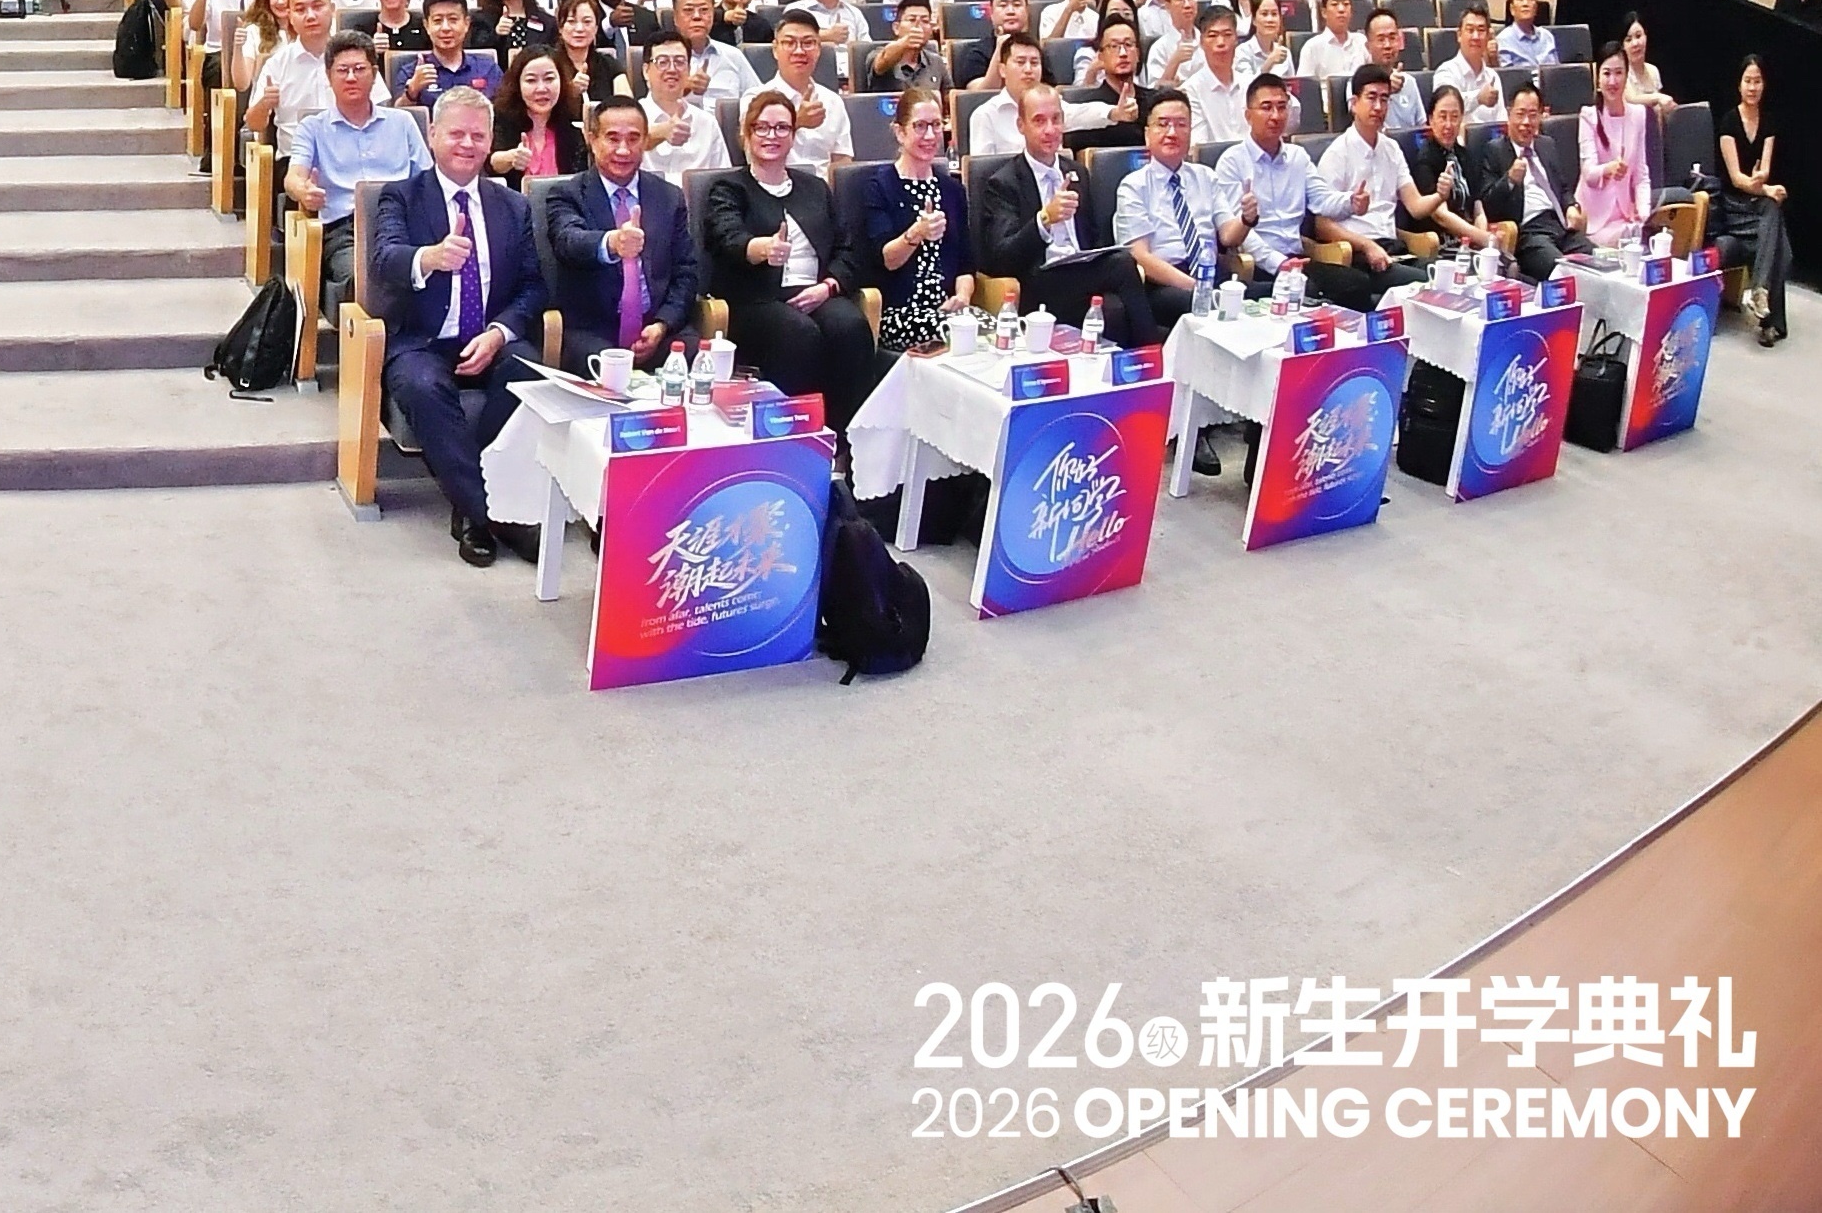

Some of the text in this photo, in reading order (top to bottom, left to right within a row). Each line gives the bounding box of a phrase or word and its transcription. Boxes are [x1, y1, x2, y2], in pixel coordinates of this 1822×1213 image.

[1056, 510, 1132, 561] Hello
[666, 621, 685, 633] the
[711, 606, 748, 622] futures
[694, 600, 730, 615] talents
